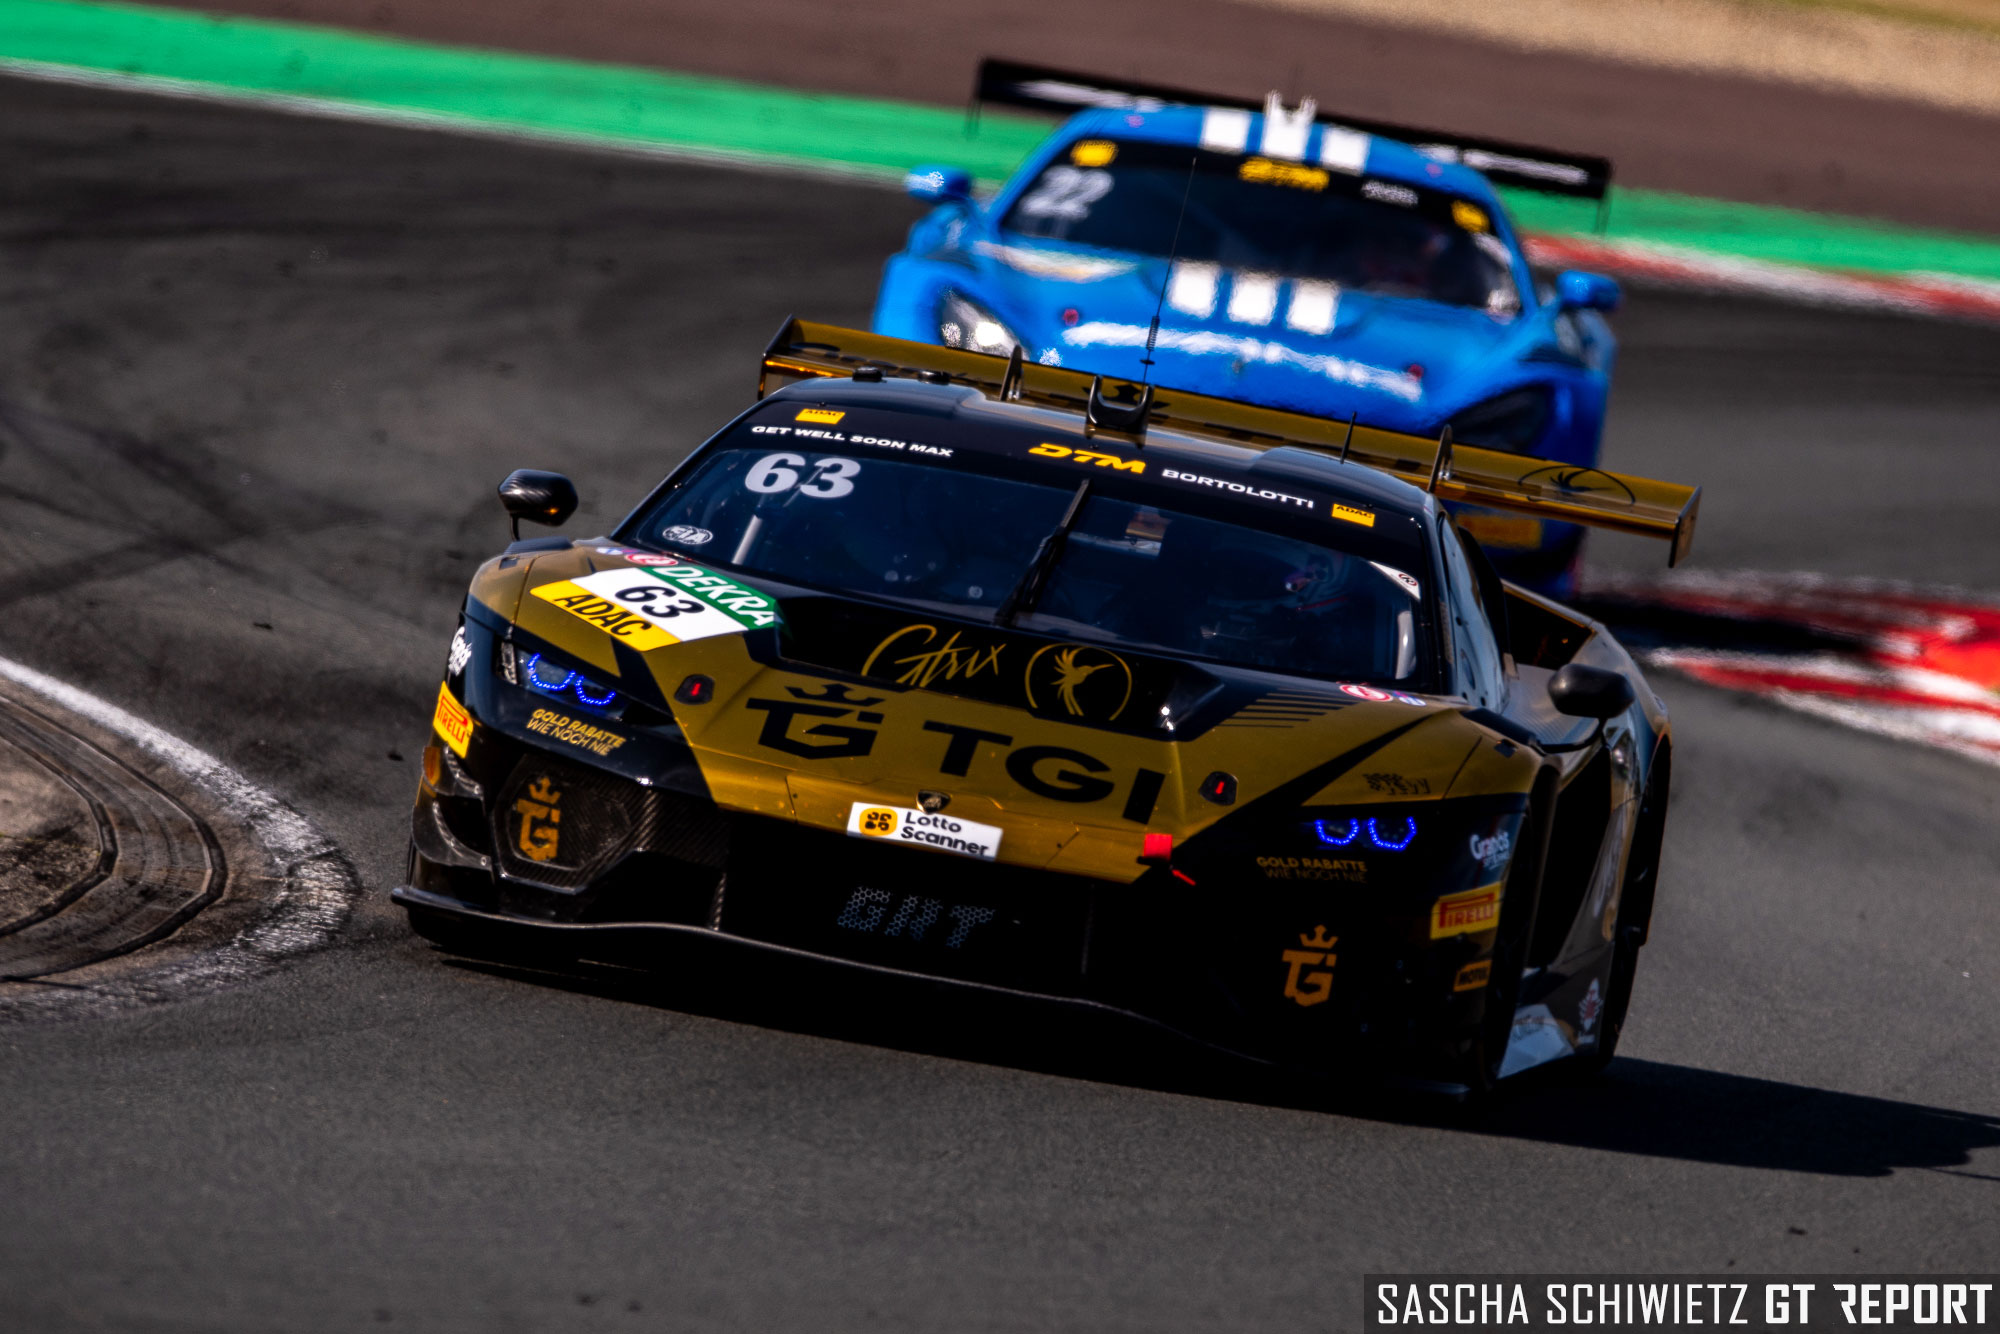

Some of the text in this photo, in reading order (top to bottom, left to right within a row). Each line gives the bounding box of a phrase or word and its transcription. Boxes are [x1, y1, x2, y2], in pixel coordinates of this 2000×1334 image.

[751, 424, 953, 458] GET WELL SOON MAX
[1028, 443, 1146, 474] DTM
[744, 453, 862, 499] 63
[1162, 469, 1314, 509] BORTOLOTTI
[615, 585, 705, 618] 63
[653, 567, 777, 626] DEKRA
[554, 593, 650, 637] ADAC
[437, 696, 468, 744] PIRELLI
[527, 719, 613, 756] WIE NOCH NIE
[533, 709, 626, 748] GOLD RABATTE
[923, 720, 1166, 825] TGI
[905, 811, 962, 833] Lotto
[901, 827, 989, 857] Scanner
[1256, 857, 1366, 871] GOLD RABATTE
[1265, 868, 1366, 884] WIE NOCH NIE
[1439, 893, 1495, 928] PIRELLI
